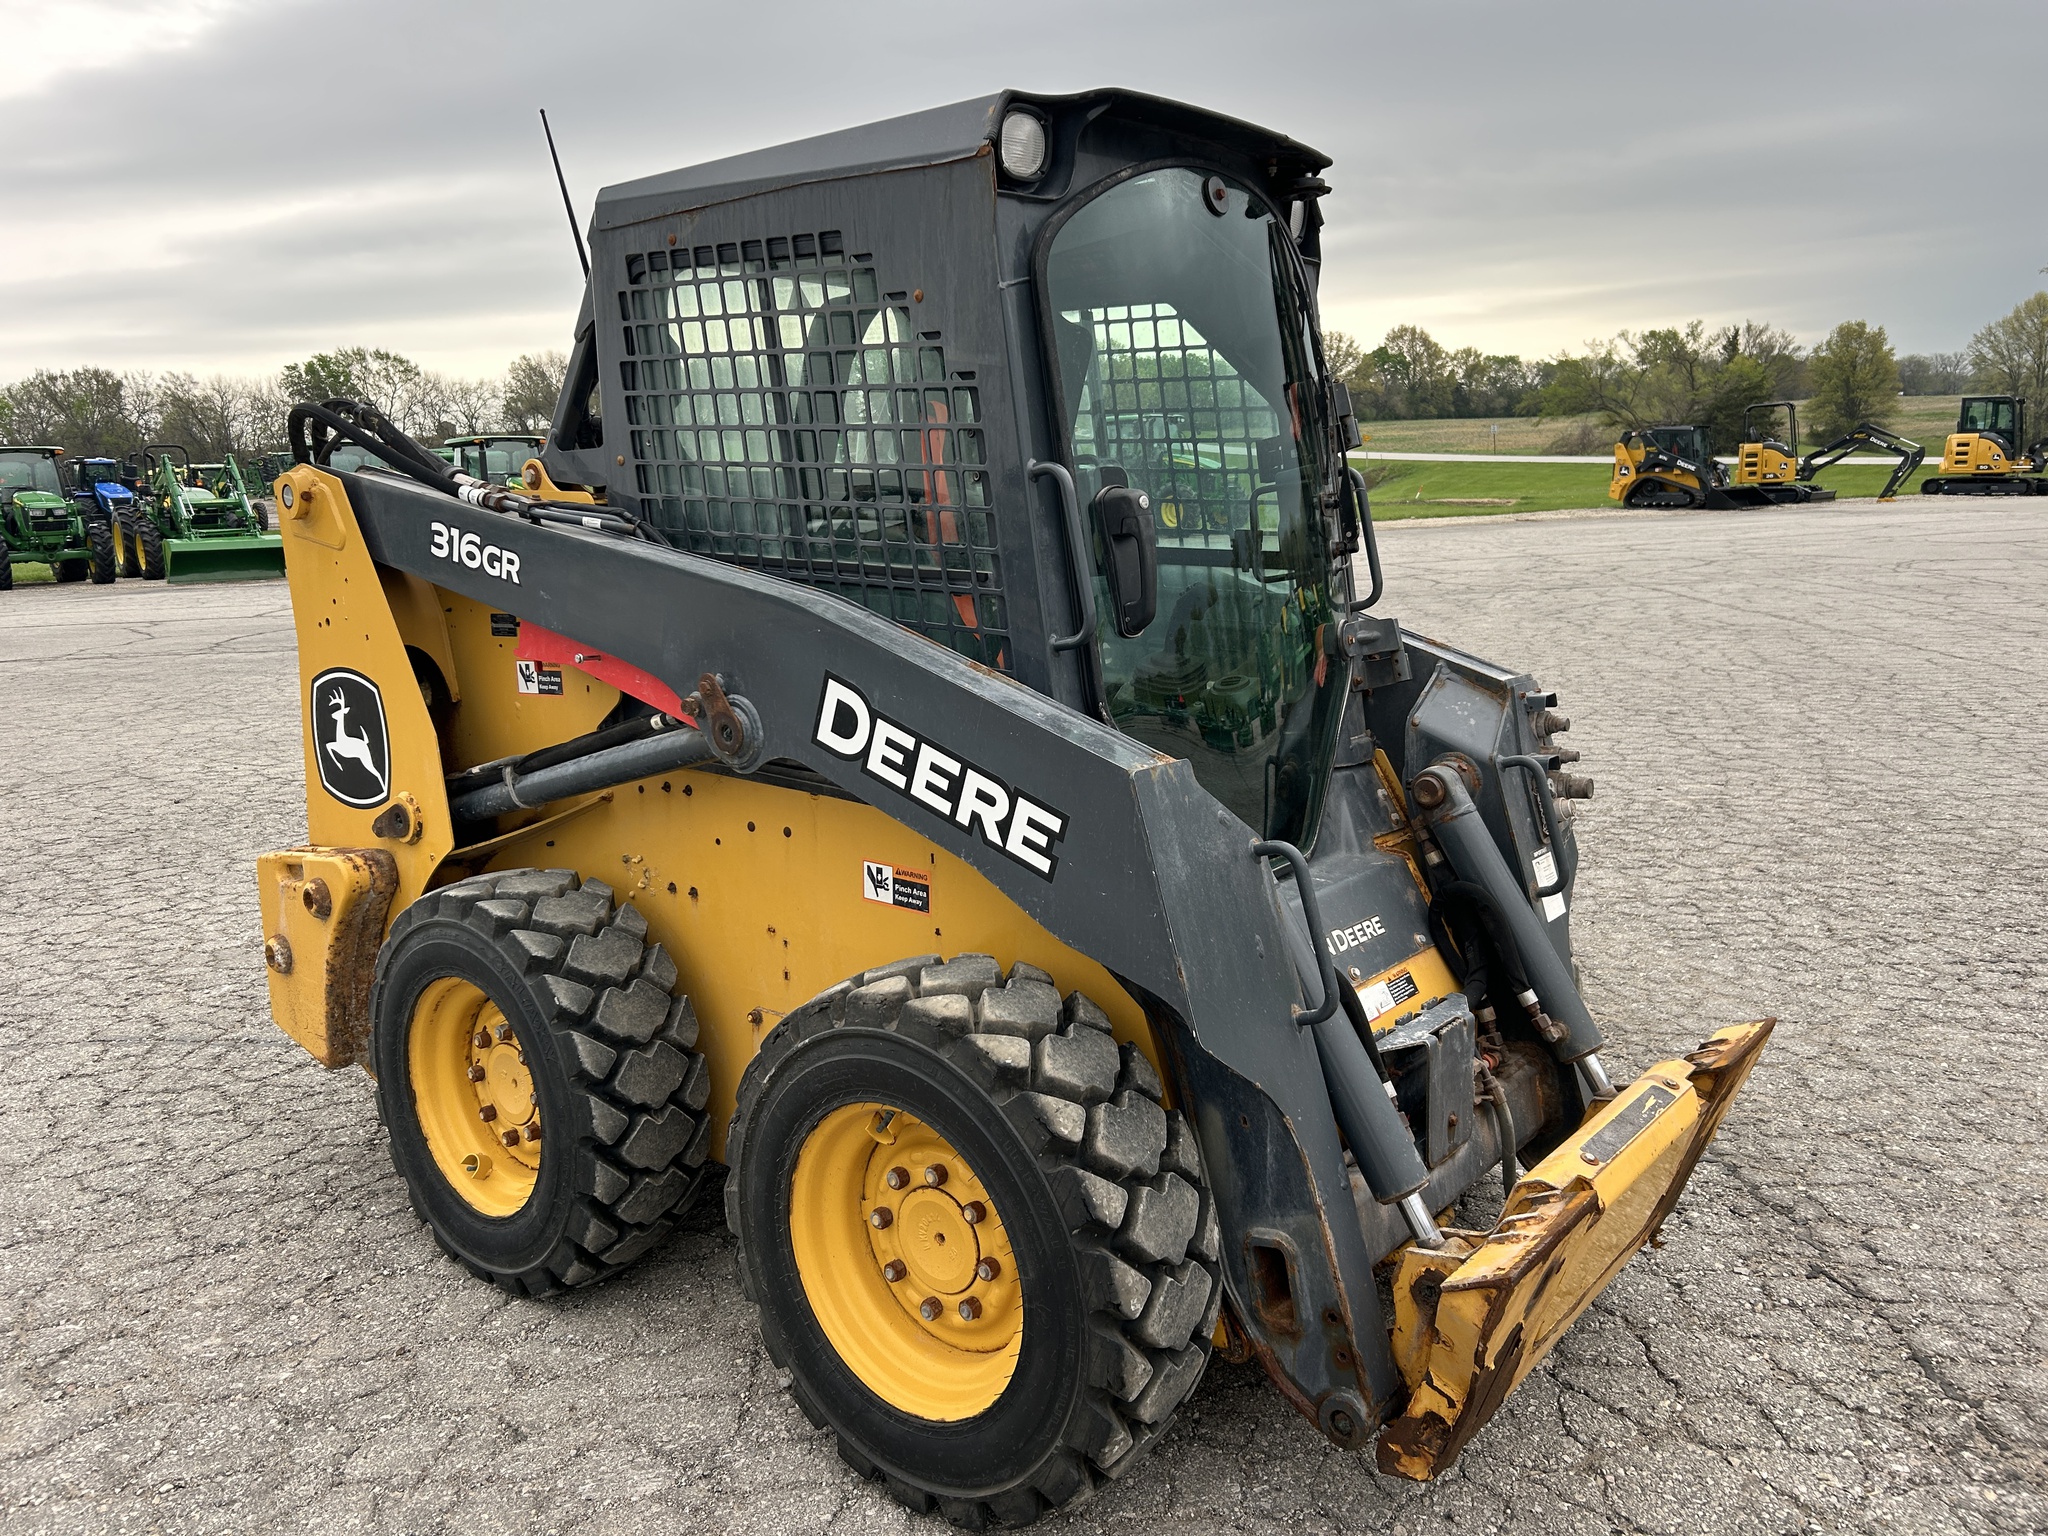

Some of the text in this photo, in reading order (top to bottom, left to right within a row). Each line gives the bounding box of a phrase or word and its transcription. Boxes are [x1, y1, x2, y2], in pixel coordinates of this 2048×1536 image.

[1870, 436, 1888, 448] DEERE
[1676, 459, 1696, 472] DEERE
[430, 522, 521, 584] 316GR
[816, 678, 1062, 874] DEERE
[901, 869, 928, 881] WARNING
[895, 884, 927, 898] Pinch Area
[895, 894, 922, 906] Keep Away
[1331, 916, 1386, 953] DEERE
